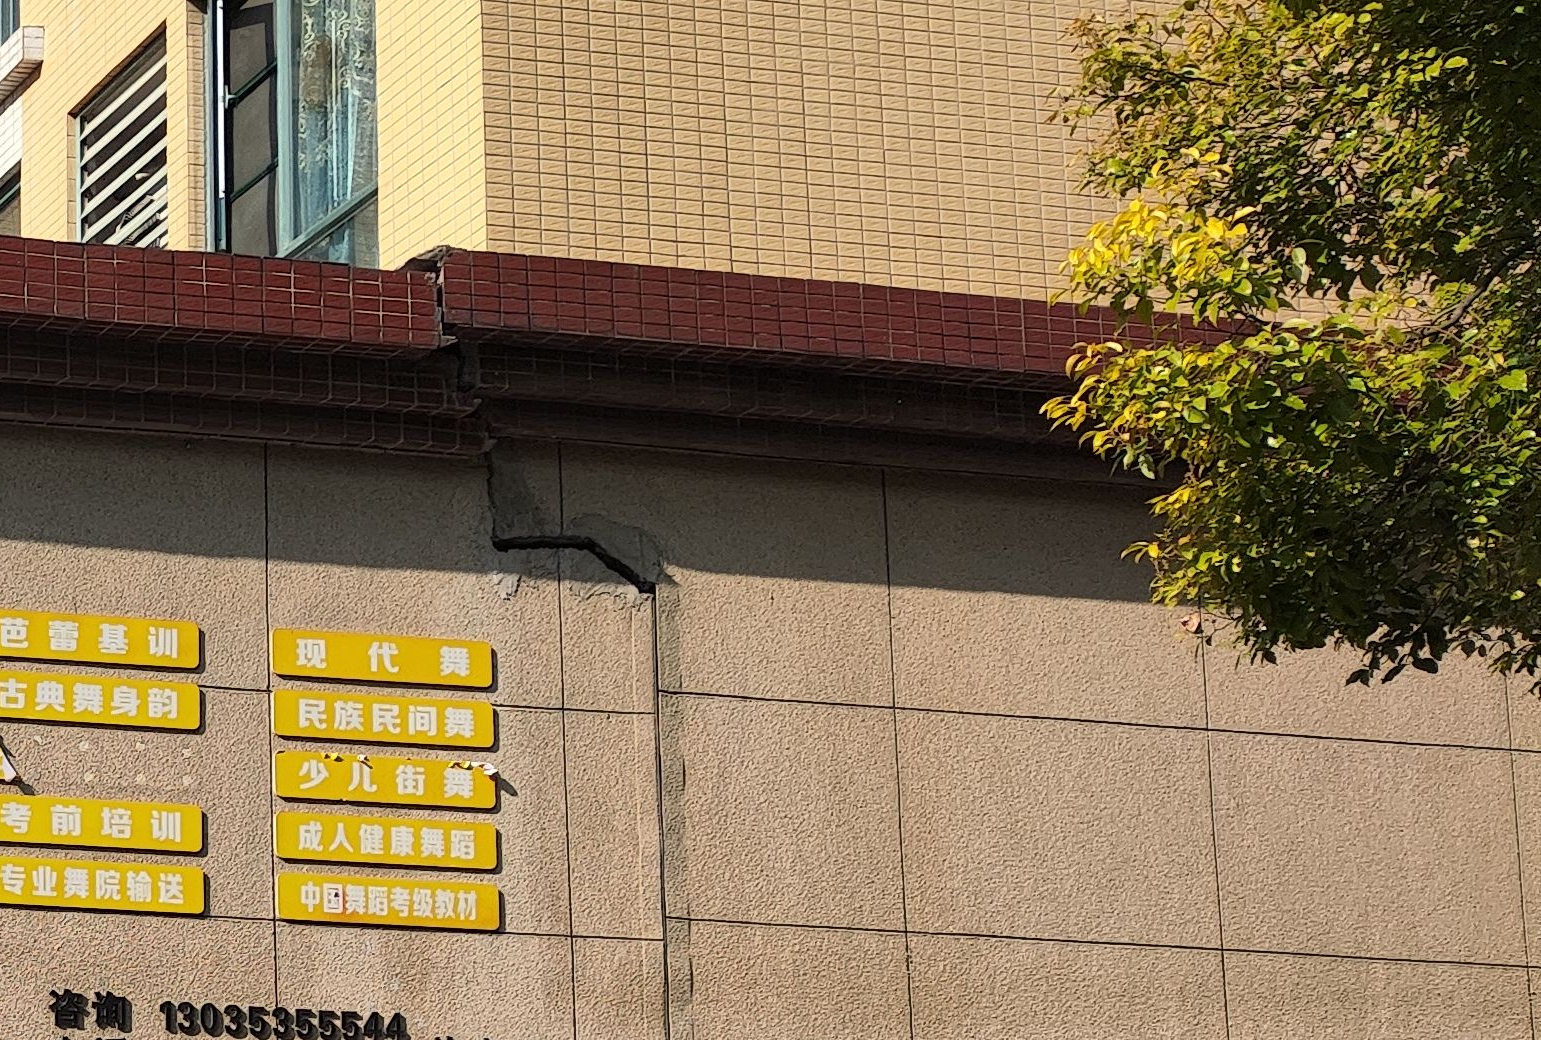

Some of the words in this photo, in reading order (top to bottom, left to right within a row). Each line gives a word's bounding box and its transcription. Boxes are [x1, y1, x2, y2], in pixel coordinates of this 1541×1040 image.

[296, 638, 470, 677] 现代舞
[299, 698, 475, 739] 民族民间舞
[299, 760, 475, 799] 少儿街舞
[0, 802, 182, 843] 考前培训
[298, 821, 475, 860] 成人健康舞蹈
[0, 864, 185, 905] 专业舞院输送
[301, 881, 478, 921] 中国舞蹈考级教材
[48, 988, 133, 1034] 咨询
